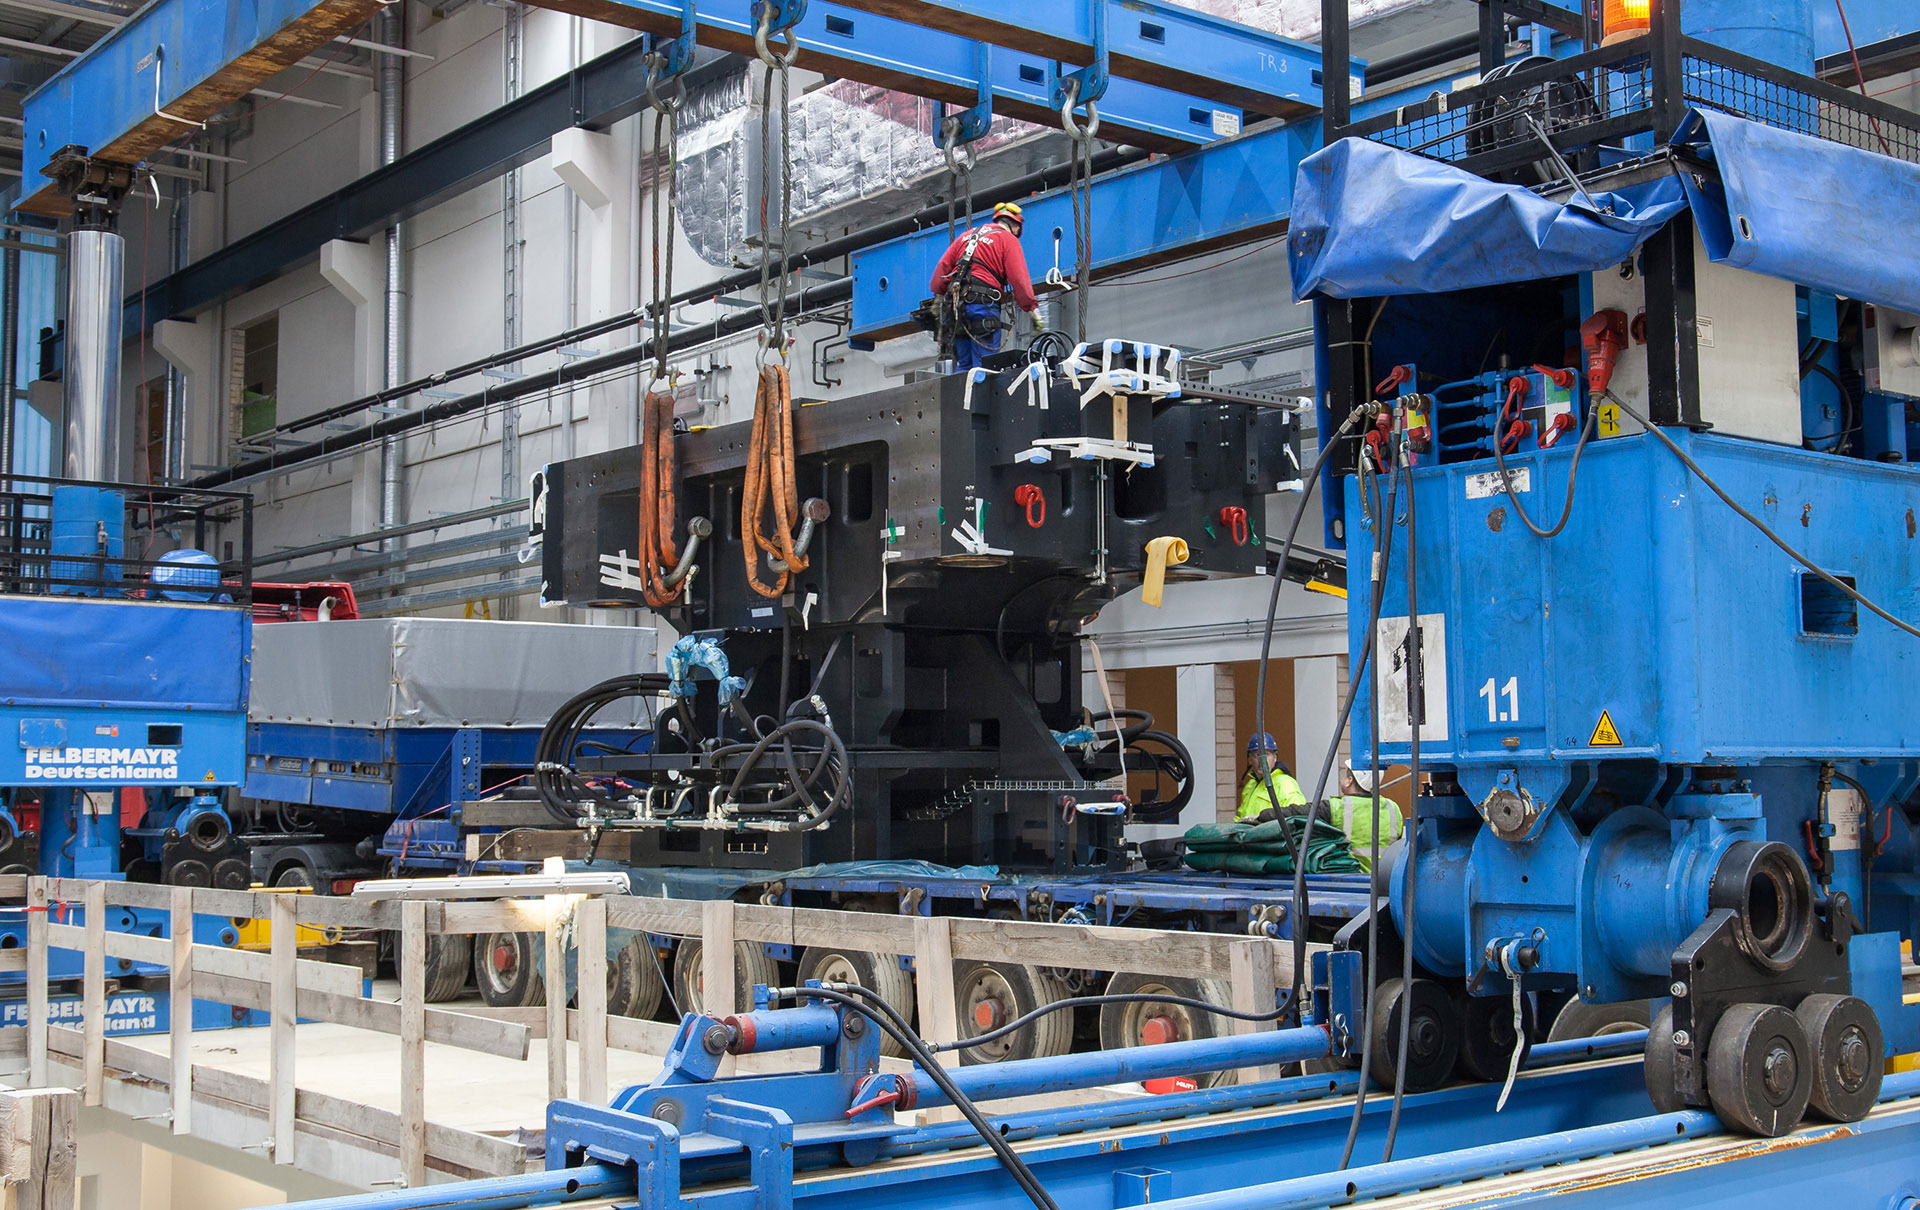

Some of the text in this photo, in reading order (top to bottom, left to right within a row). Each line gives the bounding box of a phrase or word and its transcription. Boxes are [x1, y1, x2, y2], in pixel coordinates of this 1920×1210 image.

[1257, 51, 1287, 73] TR 3
[1604, 408, 1613, 431] 1
[1392, 627, 1425, 725] 1
[1479, 676, 1519, 722] 1.1
[26, 748, 177, 764] FELBERMAYR
[26, 766, 177, 778] Deutschland
[4, 997, 155, 1021] FEBERAYR
